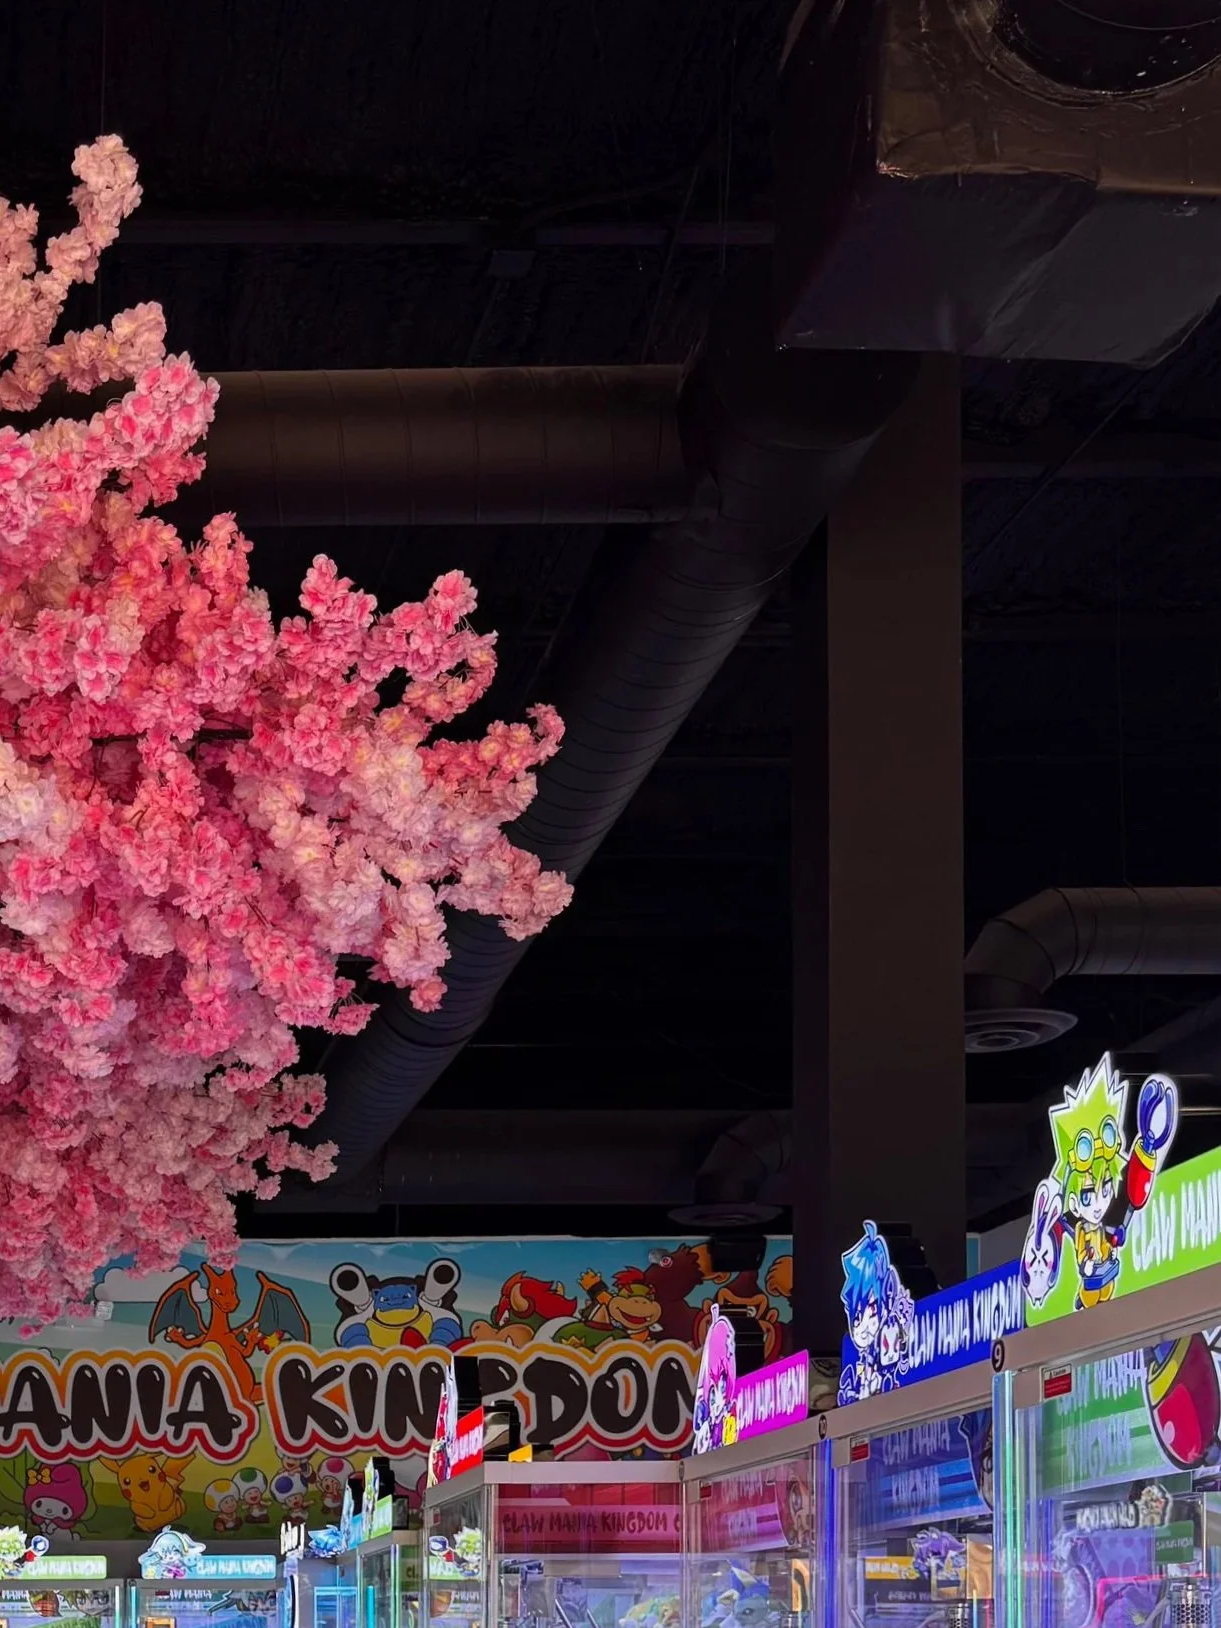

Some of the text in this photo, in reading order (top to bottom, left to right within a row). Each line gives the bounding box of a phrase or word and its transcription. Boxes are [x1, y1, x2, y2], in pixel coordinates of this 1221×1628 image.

[1132, 1191, 1176, 1273] CLAW
[909, 1273, 1021, 1367] CLAW MANIA KINGDOM
[502, 1511, 545, 1533] CLAW
[601, 1511, 667, 1534] KINGDOM
